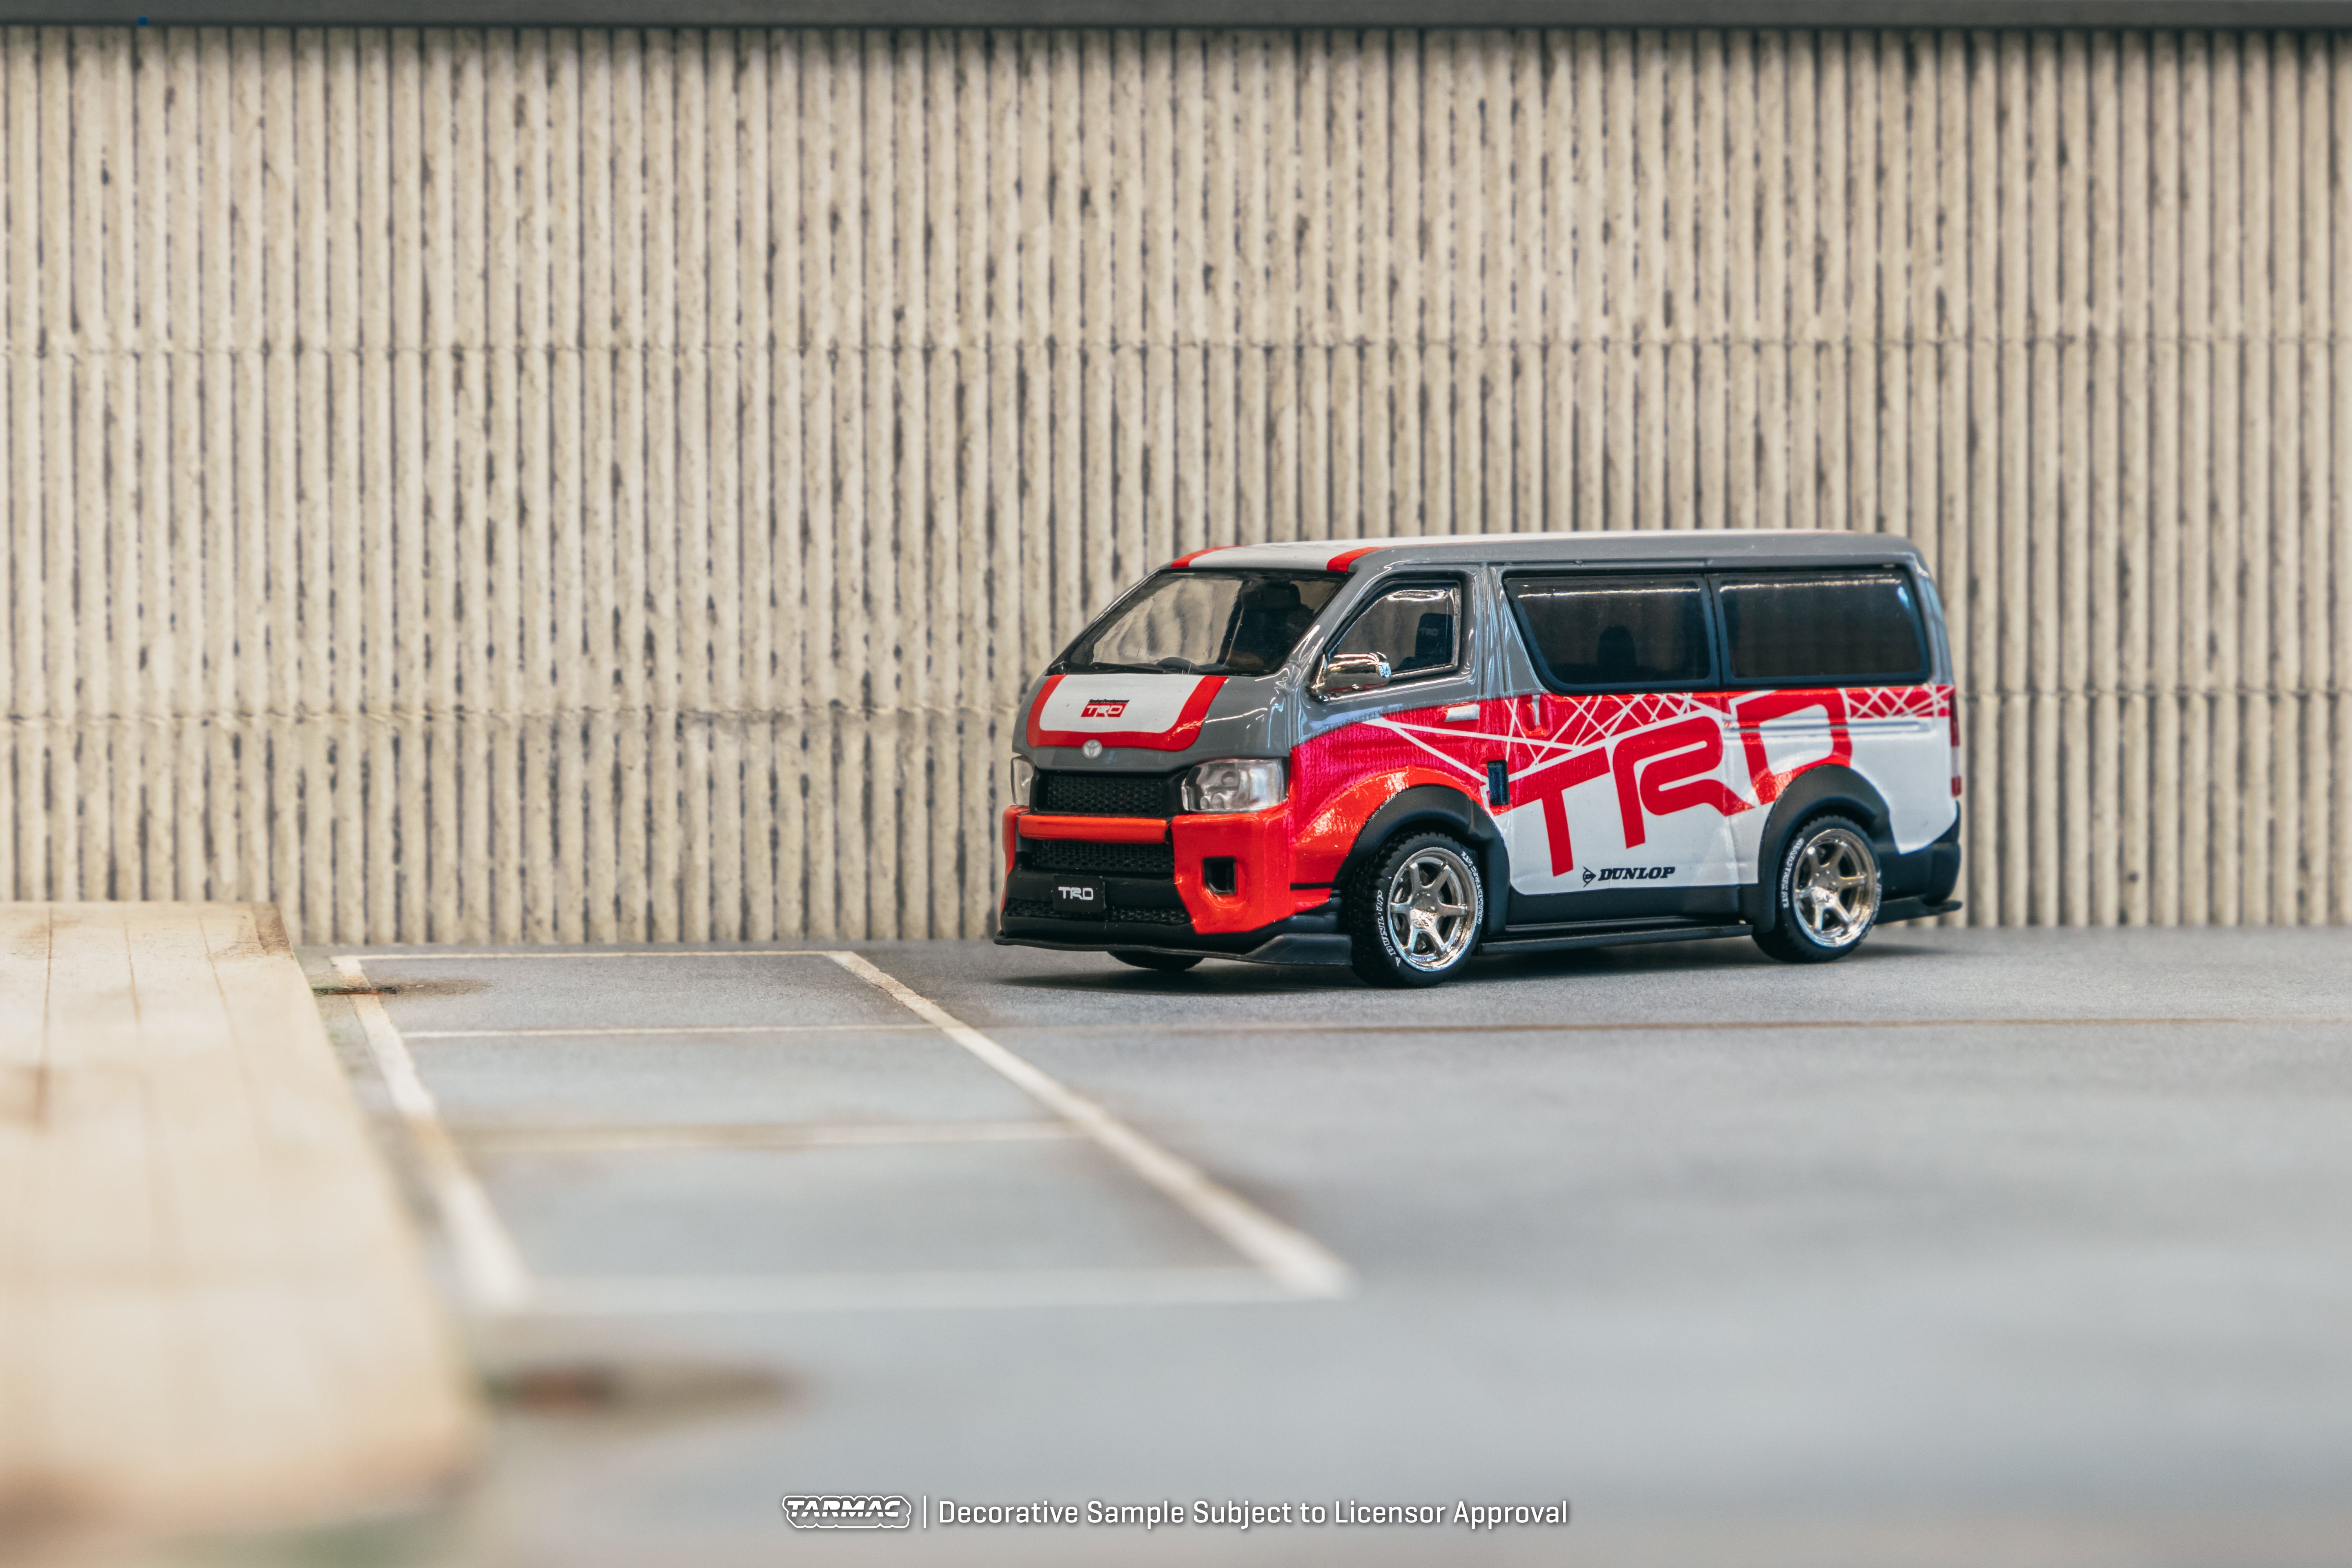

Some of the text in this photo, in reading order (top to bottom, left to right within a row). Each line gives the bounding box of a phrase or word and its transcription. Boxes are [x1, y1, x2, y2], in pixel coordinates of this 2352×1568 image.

[1087, 705, 1123, 717] TRD
[1486, 689, 1852, 877] TRD
[1597, 866, 1675, 881] DUNLOP
[1058, 886, 1094, 900] TRD
